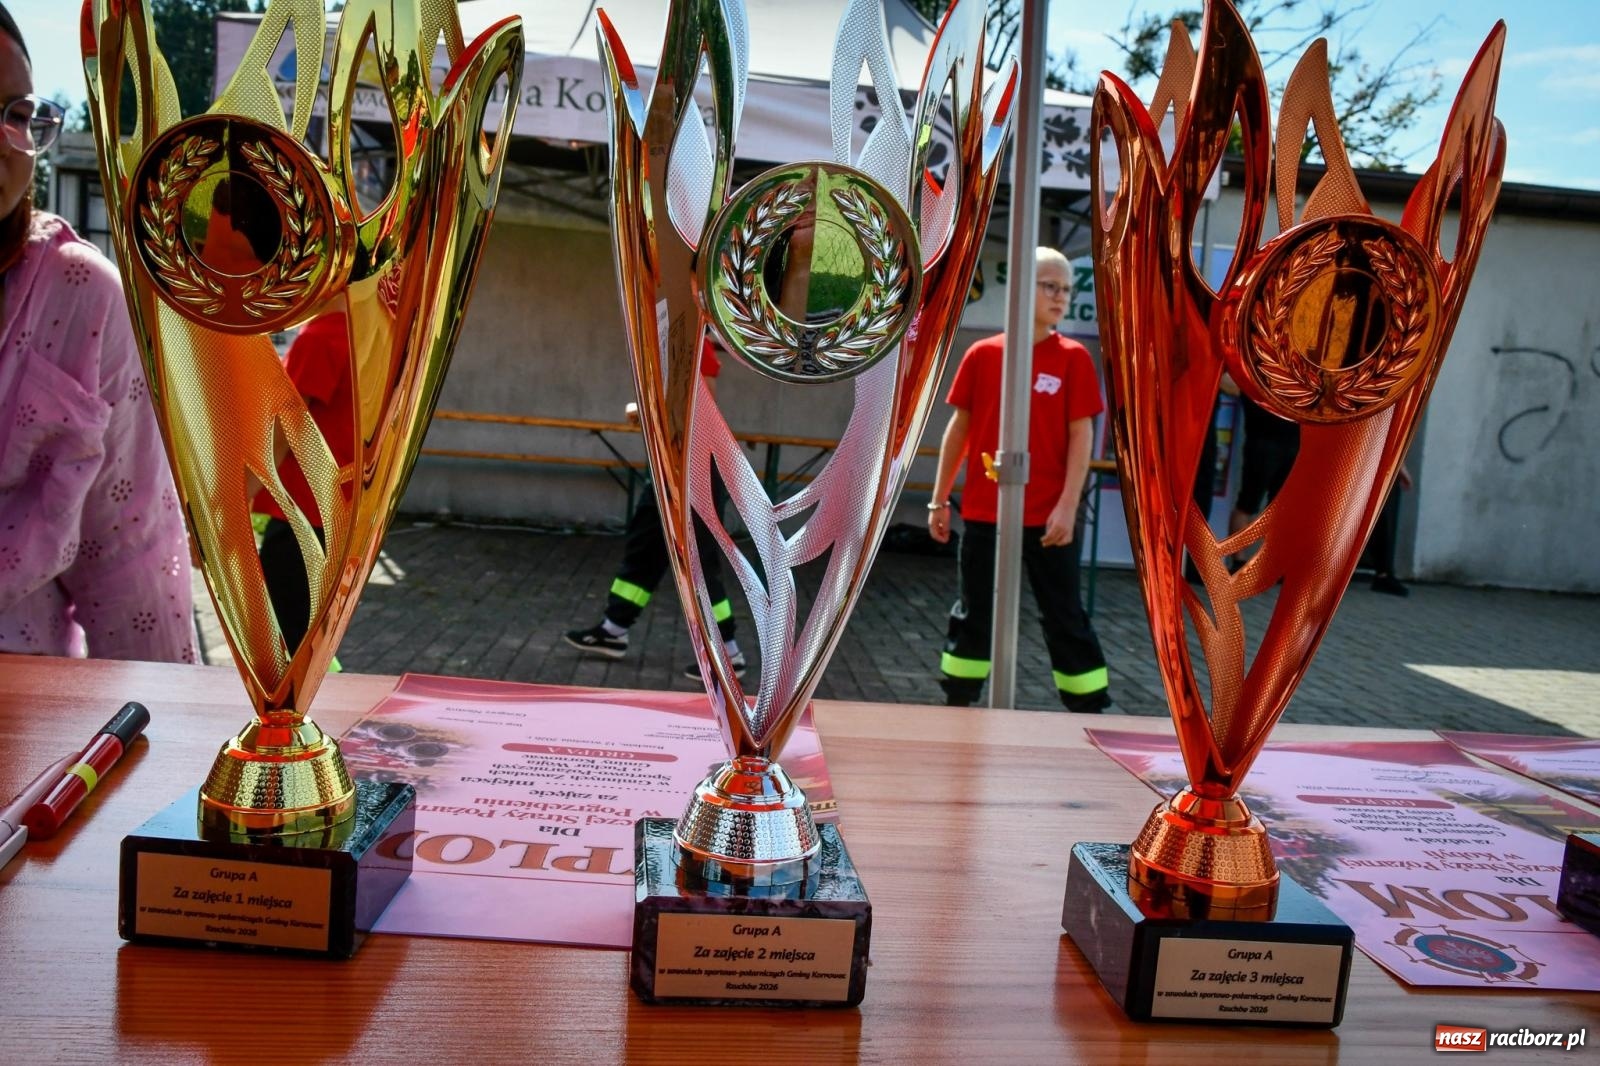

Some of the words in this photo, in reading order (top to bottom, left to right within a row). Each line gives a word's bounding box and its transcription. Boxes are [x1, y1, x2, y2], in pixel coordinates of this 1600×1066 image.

[567, 748, 634, 758] GRUPA
[460, 776, 534, 787] miejsca
[529, 790, 592, 800] zajęcie
[473, 798, 632, 817] Pogrzebieniu
[643, 807, 662, 817] w
[502, 809, 579, 825] Straży
[539, 825, 581, 837] Dla
[1336, 858, 1440, 871] Pożarnej
[210, 867, 245, 882] Grupa
[249, 871, 257, 882] A
[1495, 876, 1543, 887] Dla
[173, 886, 188, 898] Za
[192, 888, 232, 904] zajęcie
[236, 893, 243, 904] 1
[247, 895, 292, 910] miejsca
[1331, 879, 1569, 922] LOM
[733, 923, 769, 937] Grupa
[772, 927, 781, 936] A
[694, 945, 710, 958] Za
[713, 947, 753, 961] zajęcie
[758, 948, 766, 958] 2
[770, 948, 815, 962] miejsca
[1228, 948, 1262, 961] Grupa
[1264, 952, 1272, 960] A
[1191, 969, 1206, 980] Za
[1209, 970, 1247, 984] zajęcie
[1250, 971, 1257, 982] 3
[1261, 972, 1304, 986] miejsca
[1250, 1005, 1268, 1013] 2026
